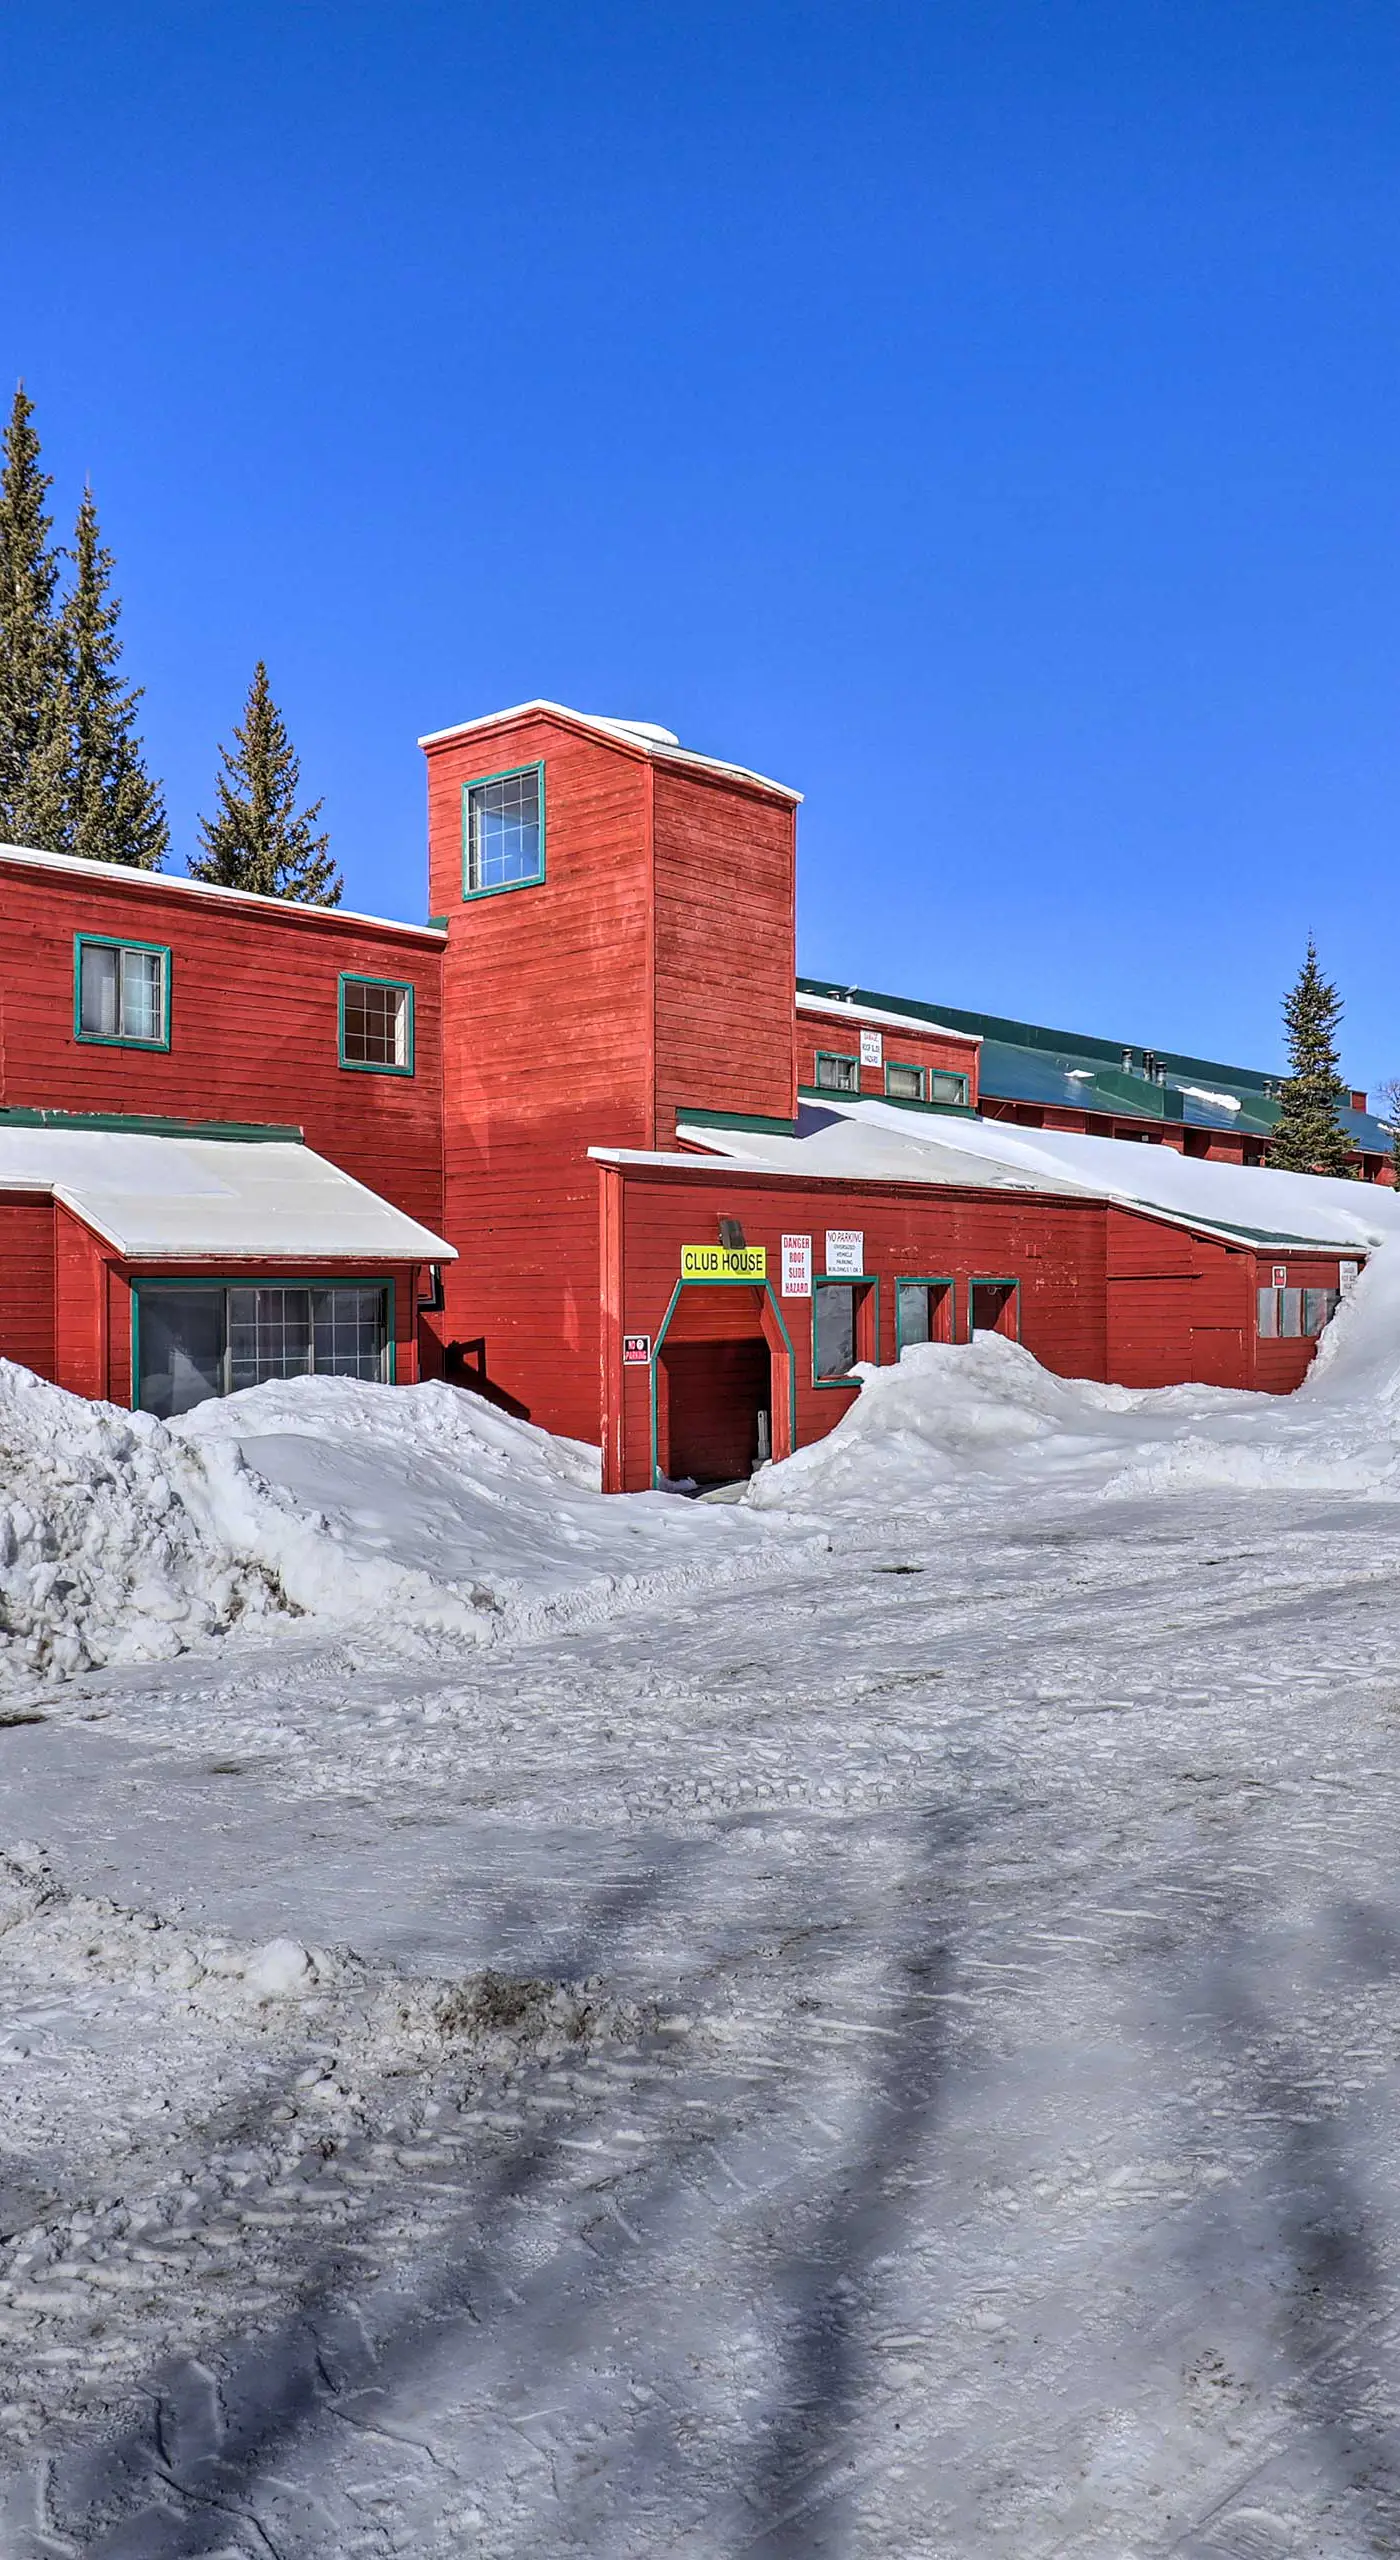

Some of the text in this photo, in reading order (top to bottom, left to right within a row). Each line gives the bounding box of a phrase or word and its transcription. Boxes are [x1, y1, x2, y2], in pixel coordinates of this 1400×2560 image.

[783, 1237, 810, 1248] DANGER
[828, 1232, 862, 1243] NO PARKING
[685, 1253, 763, 1271] CLUB HOUSE
[789, 1252, 804, 1263] ROOF
[788, 1267, 805, 1278] SLIDE
[785, 1282, 808, 1294] HAZARD
[628, 1340, 636, 1350] NO
[625, 1351, 647, 1360] PARKING
